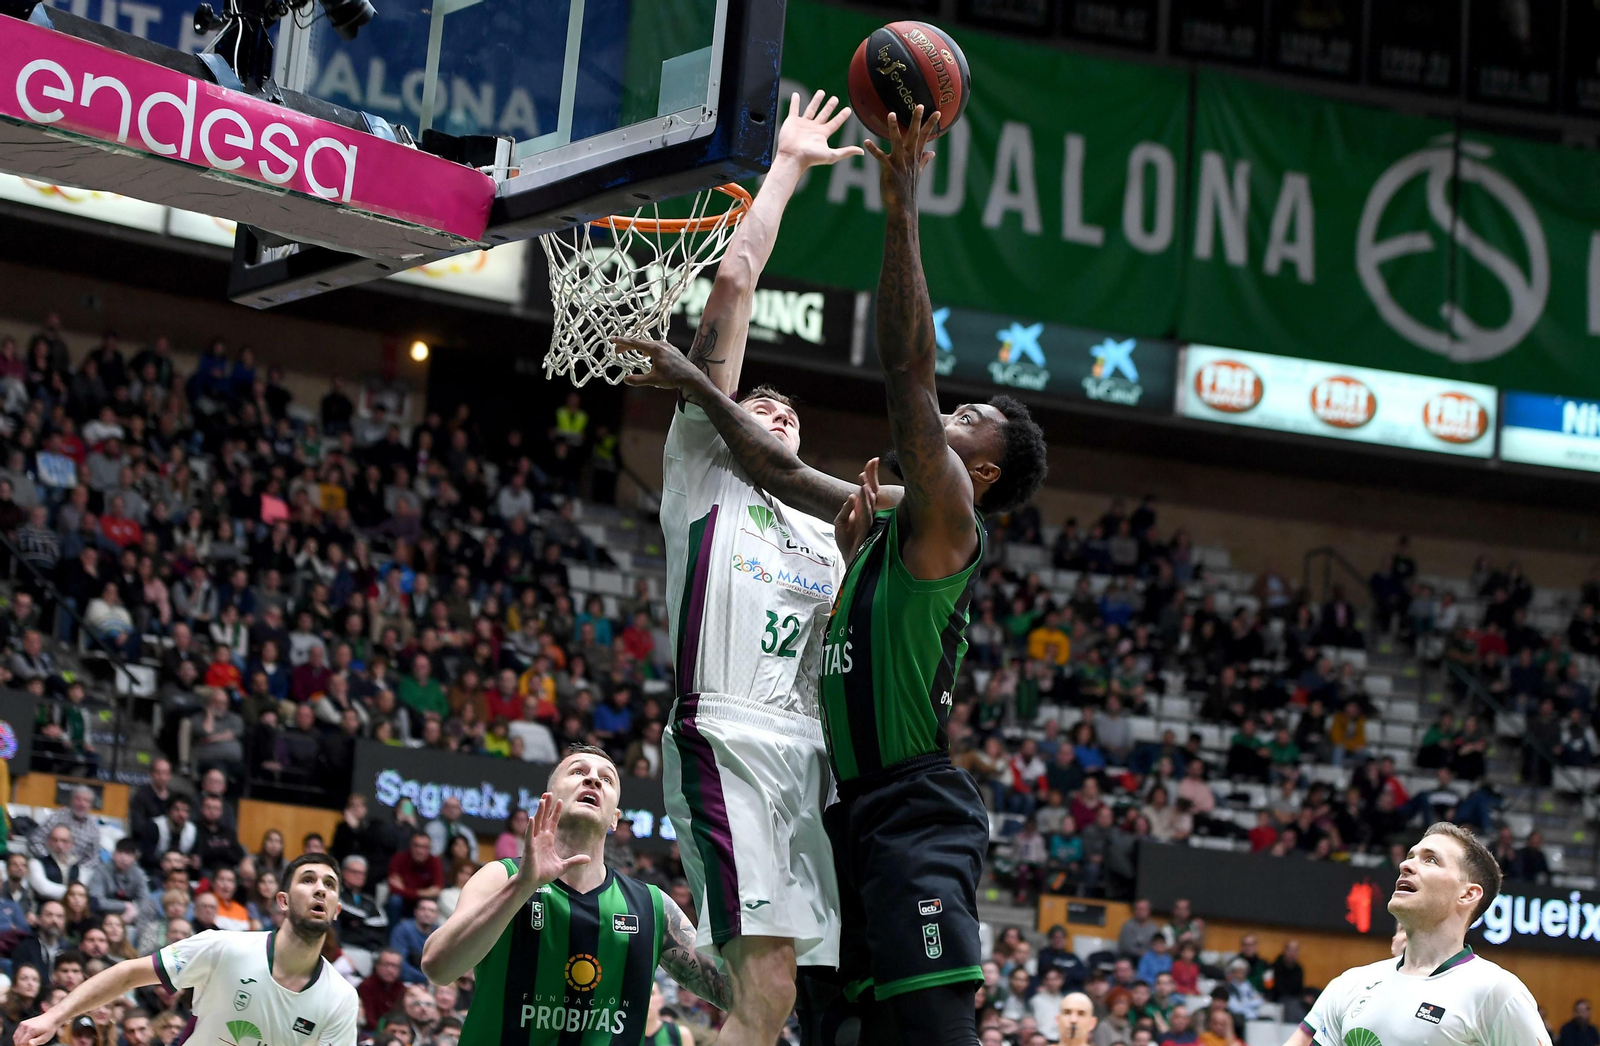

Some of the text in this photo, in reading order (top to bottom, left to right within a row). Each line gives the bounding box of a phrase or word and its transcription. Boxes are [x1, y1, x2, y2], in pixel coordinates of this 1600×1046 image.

[902, 28, 957, 106] SPALDING
[890, 71, 918, 115] endes
[15, 58, 358, 203] endesa
[733, 554, 833, 595] 2020 MÁLAG
[776, 580, 801, 593] EUROPEAN
[761, 609, 800, 658] 32
[819, 640, 853, 677] ITAS
[921, 904, 937, 913] acb
[1470, 890, 1600, 945] gueix
[520, 1004, 627, 1035] PROBITAS
[522, 993, 630, 1007] FUNDACIÓN
